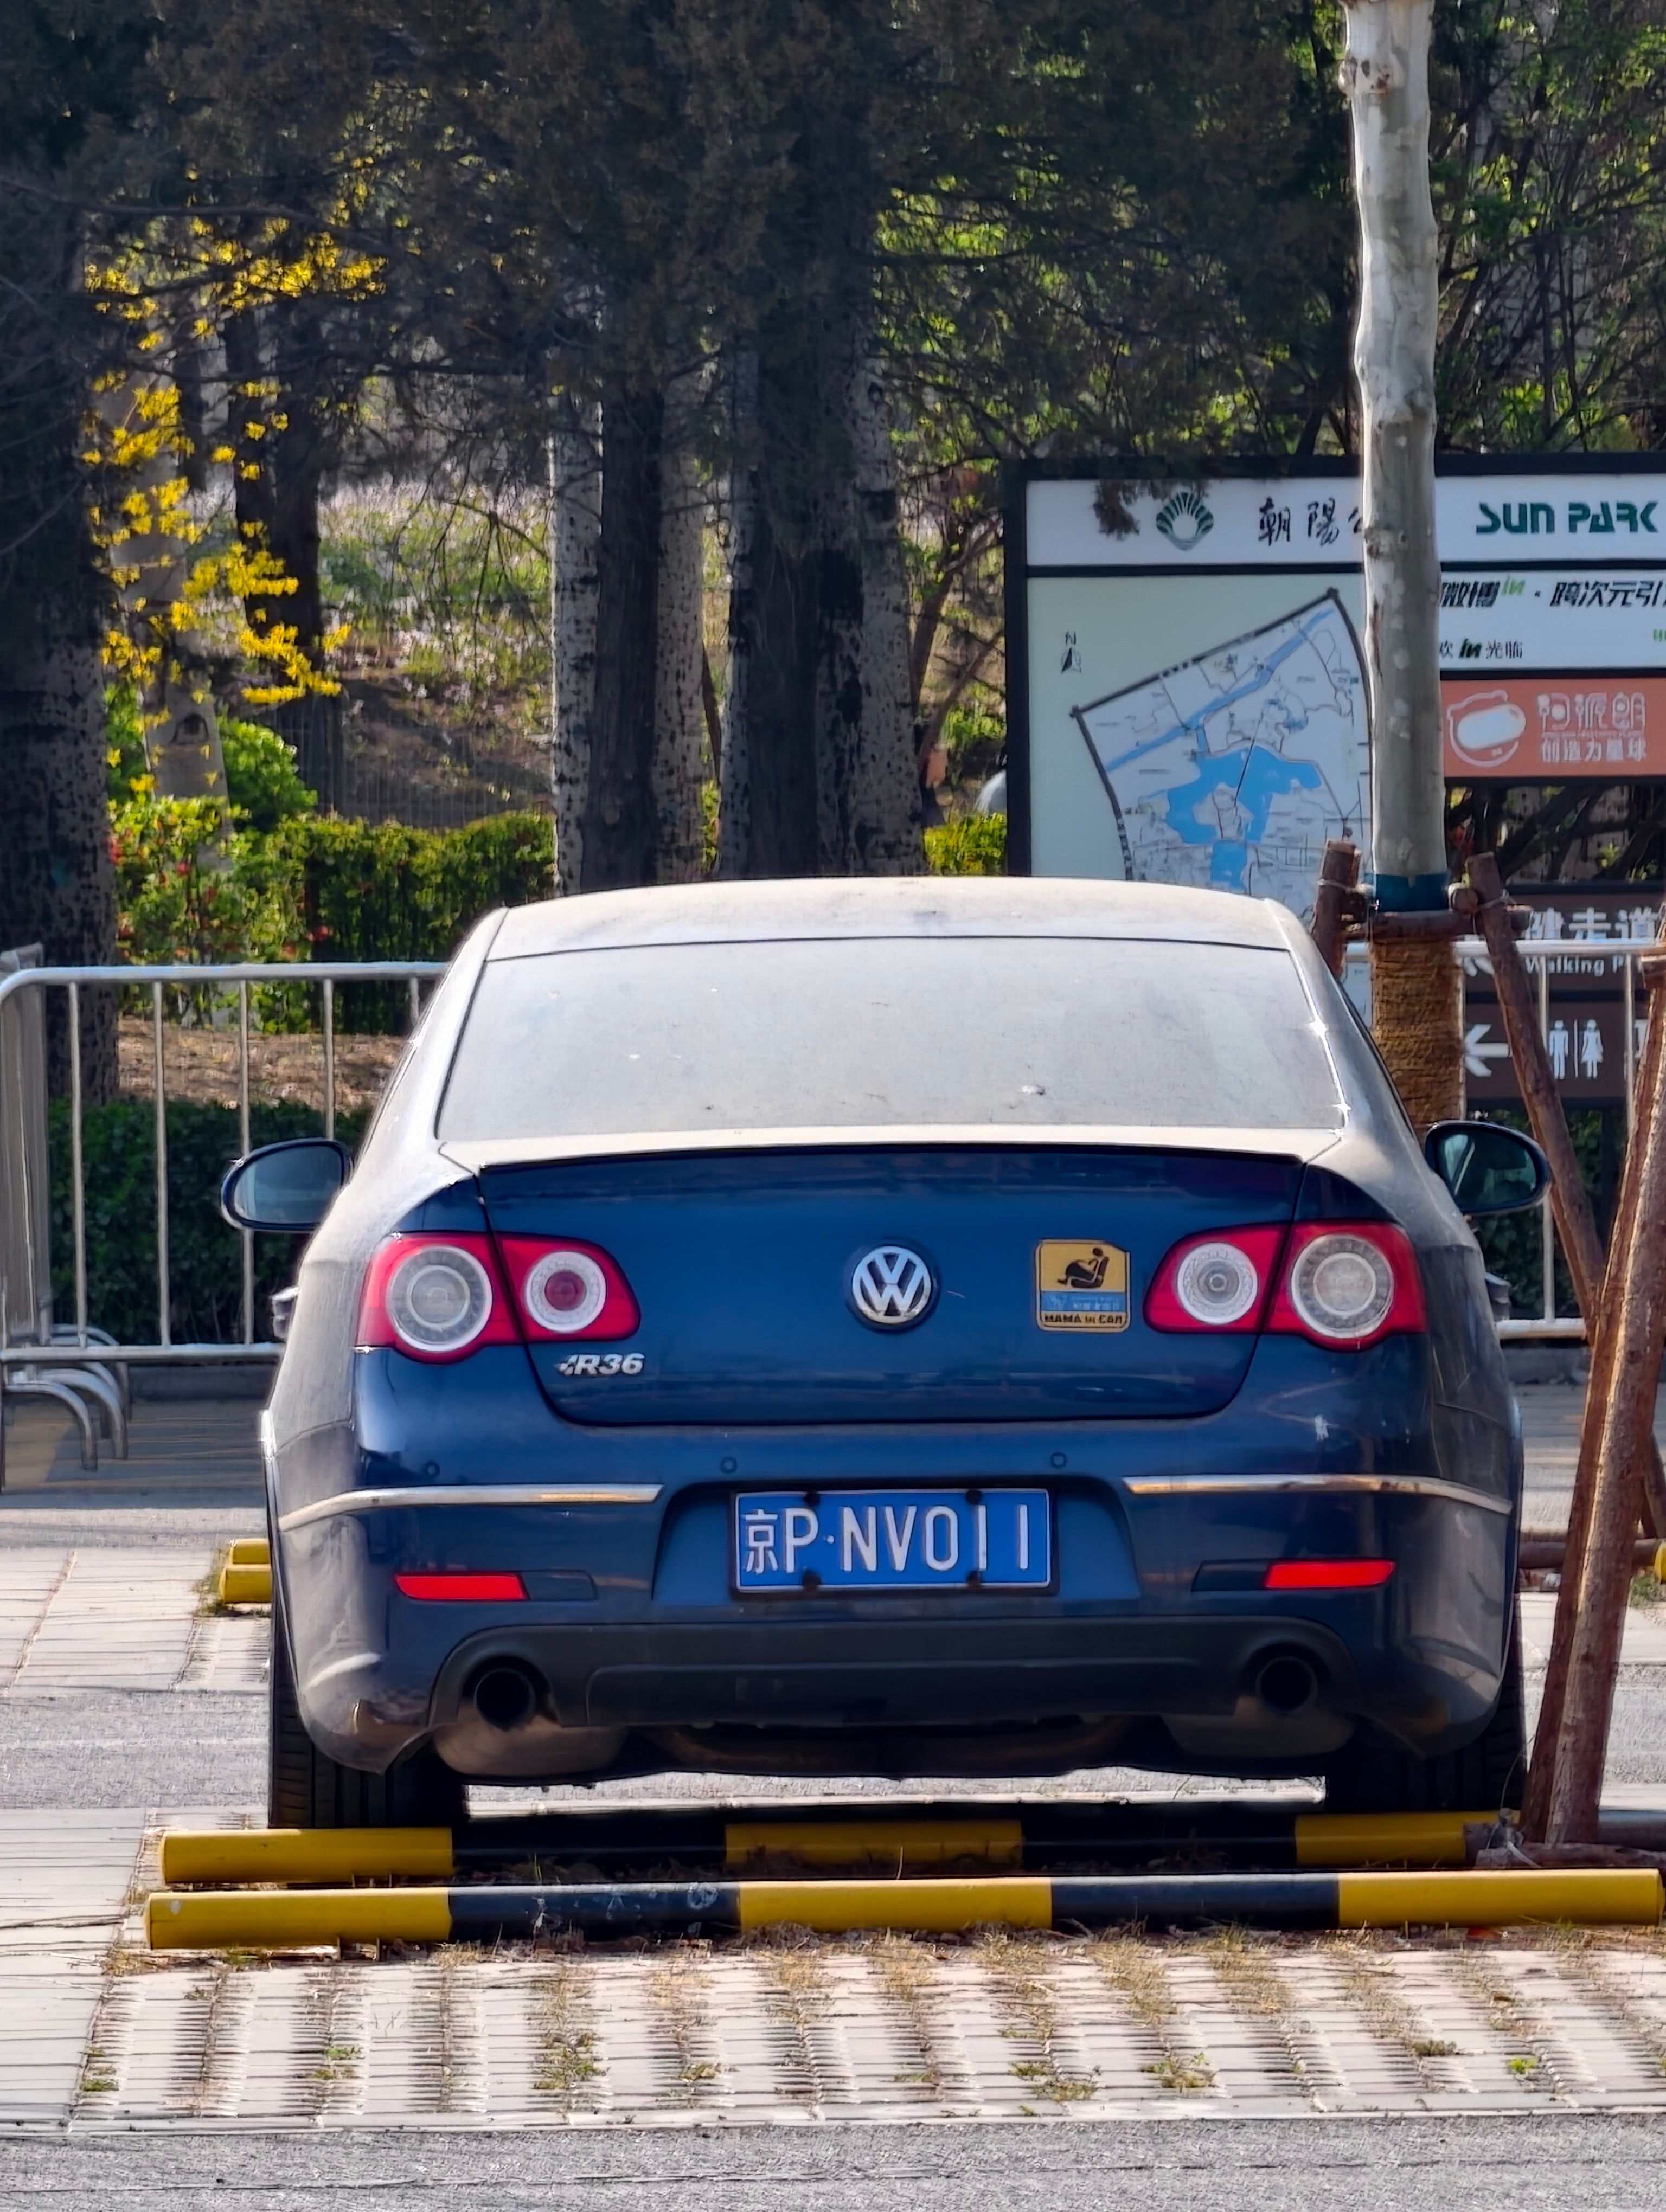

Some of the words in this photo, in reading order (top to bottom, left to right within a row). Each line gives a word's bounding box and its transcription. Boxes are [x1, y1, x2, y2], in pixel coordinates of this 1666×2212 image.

[1476, 502, 1555, 534] SUN
[1568, 501, 1659, 533] PARK
[1045, 1313, 1082, 1323] MAMA
